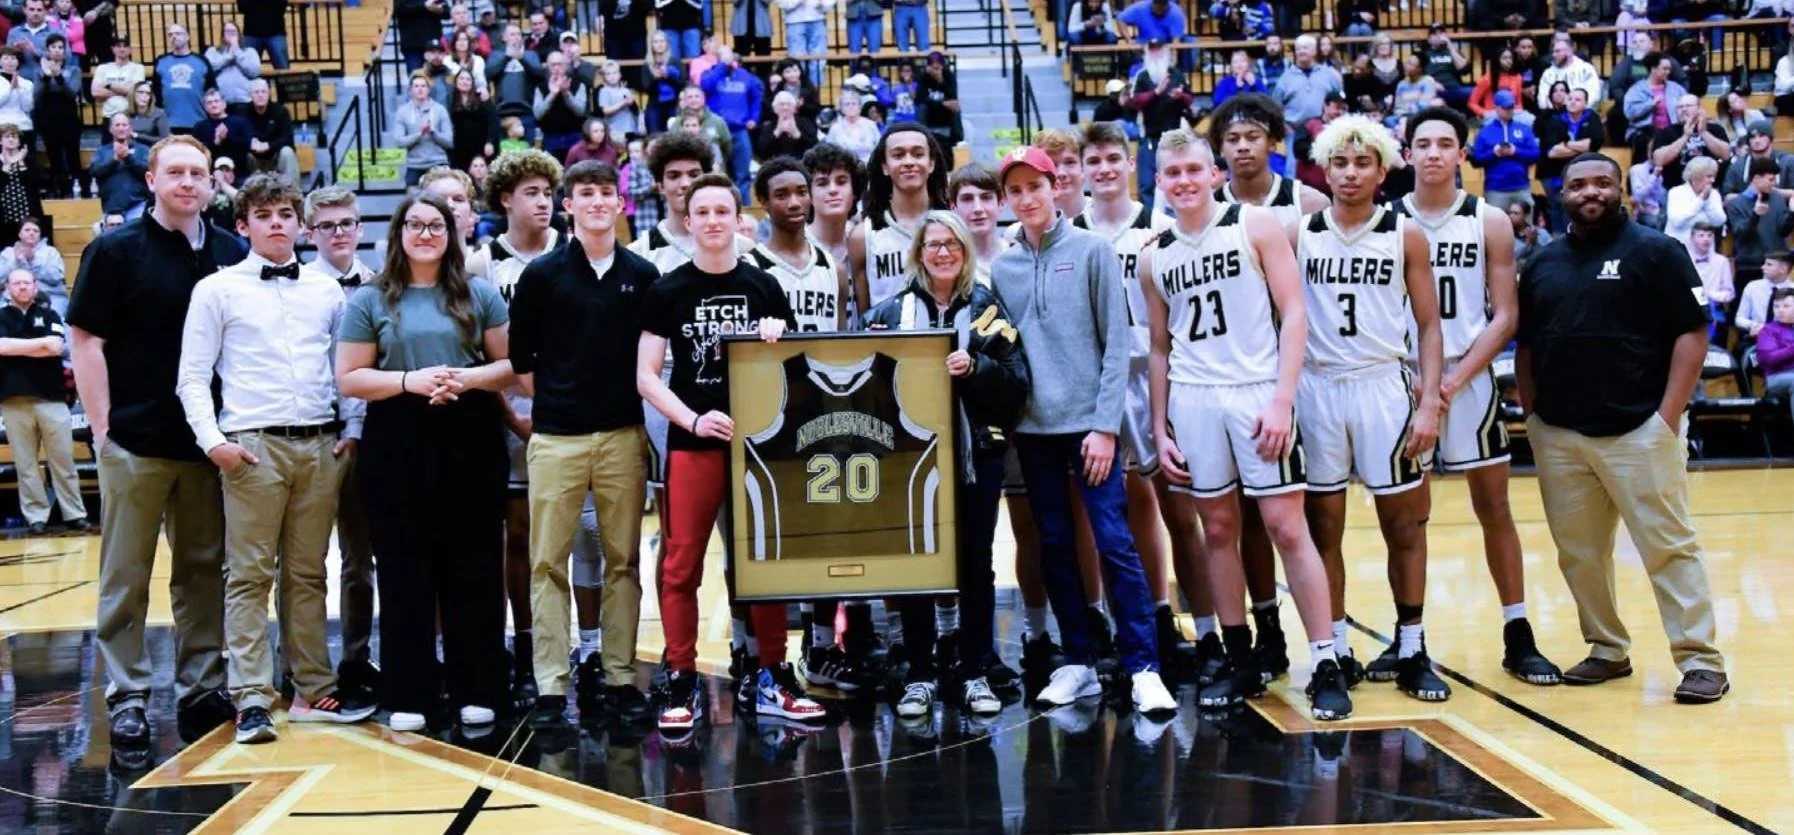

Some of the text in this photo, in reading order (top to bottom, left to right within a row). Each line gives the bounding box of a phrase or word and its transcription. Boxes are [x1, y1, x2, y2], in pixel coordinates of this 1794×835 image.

[1162, 250, 1241, 298] MILLERS
[1306, 257, 1394, 286] MILLERS
[1600, 259, 1621, 275] N
[695, 304, 748, 321] ETCH
[786, 290, 835, 318] LLERS
[1188, 290, 1227, 342] 23
[1337, 293, 1357, 337] 3
[681, 320, 760, 338] STRONG
[795, 411, 895, 453] NOBLESVILLE
[806, 453, 880, 503] 20
